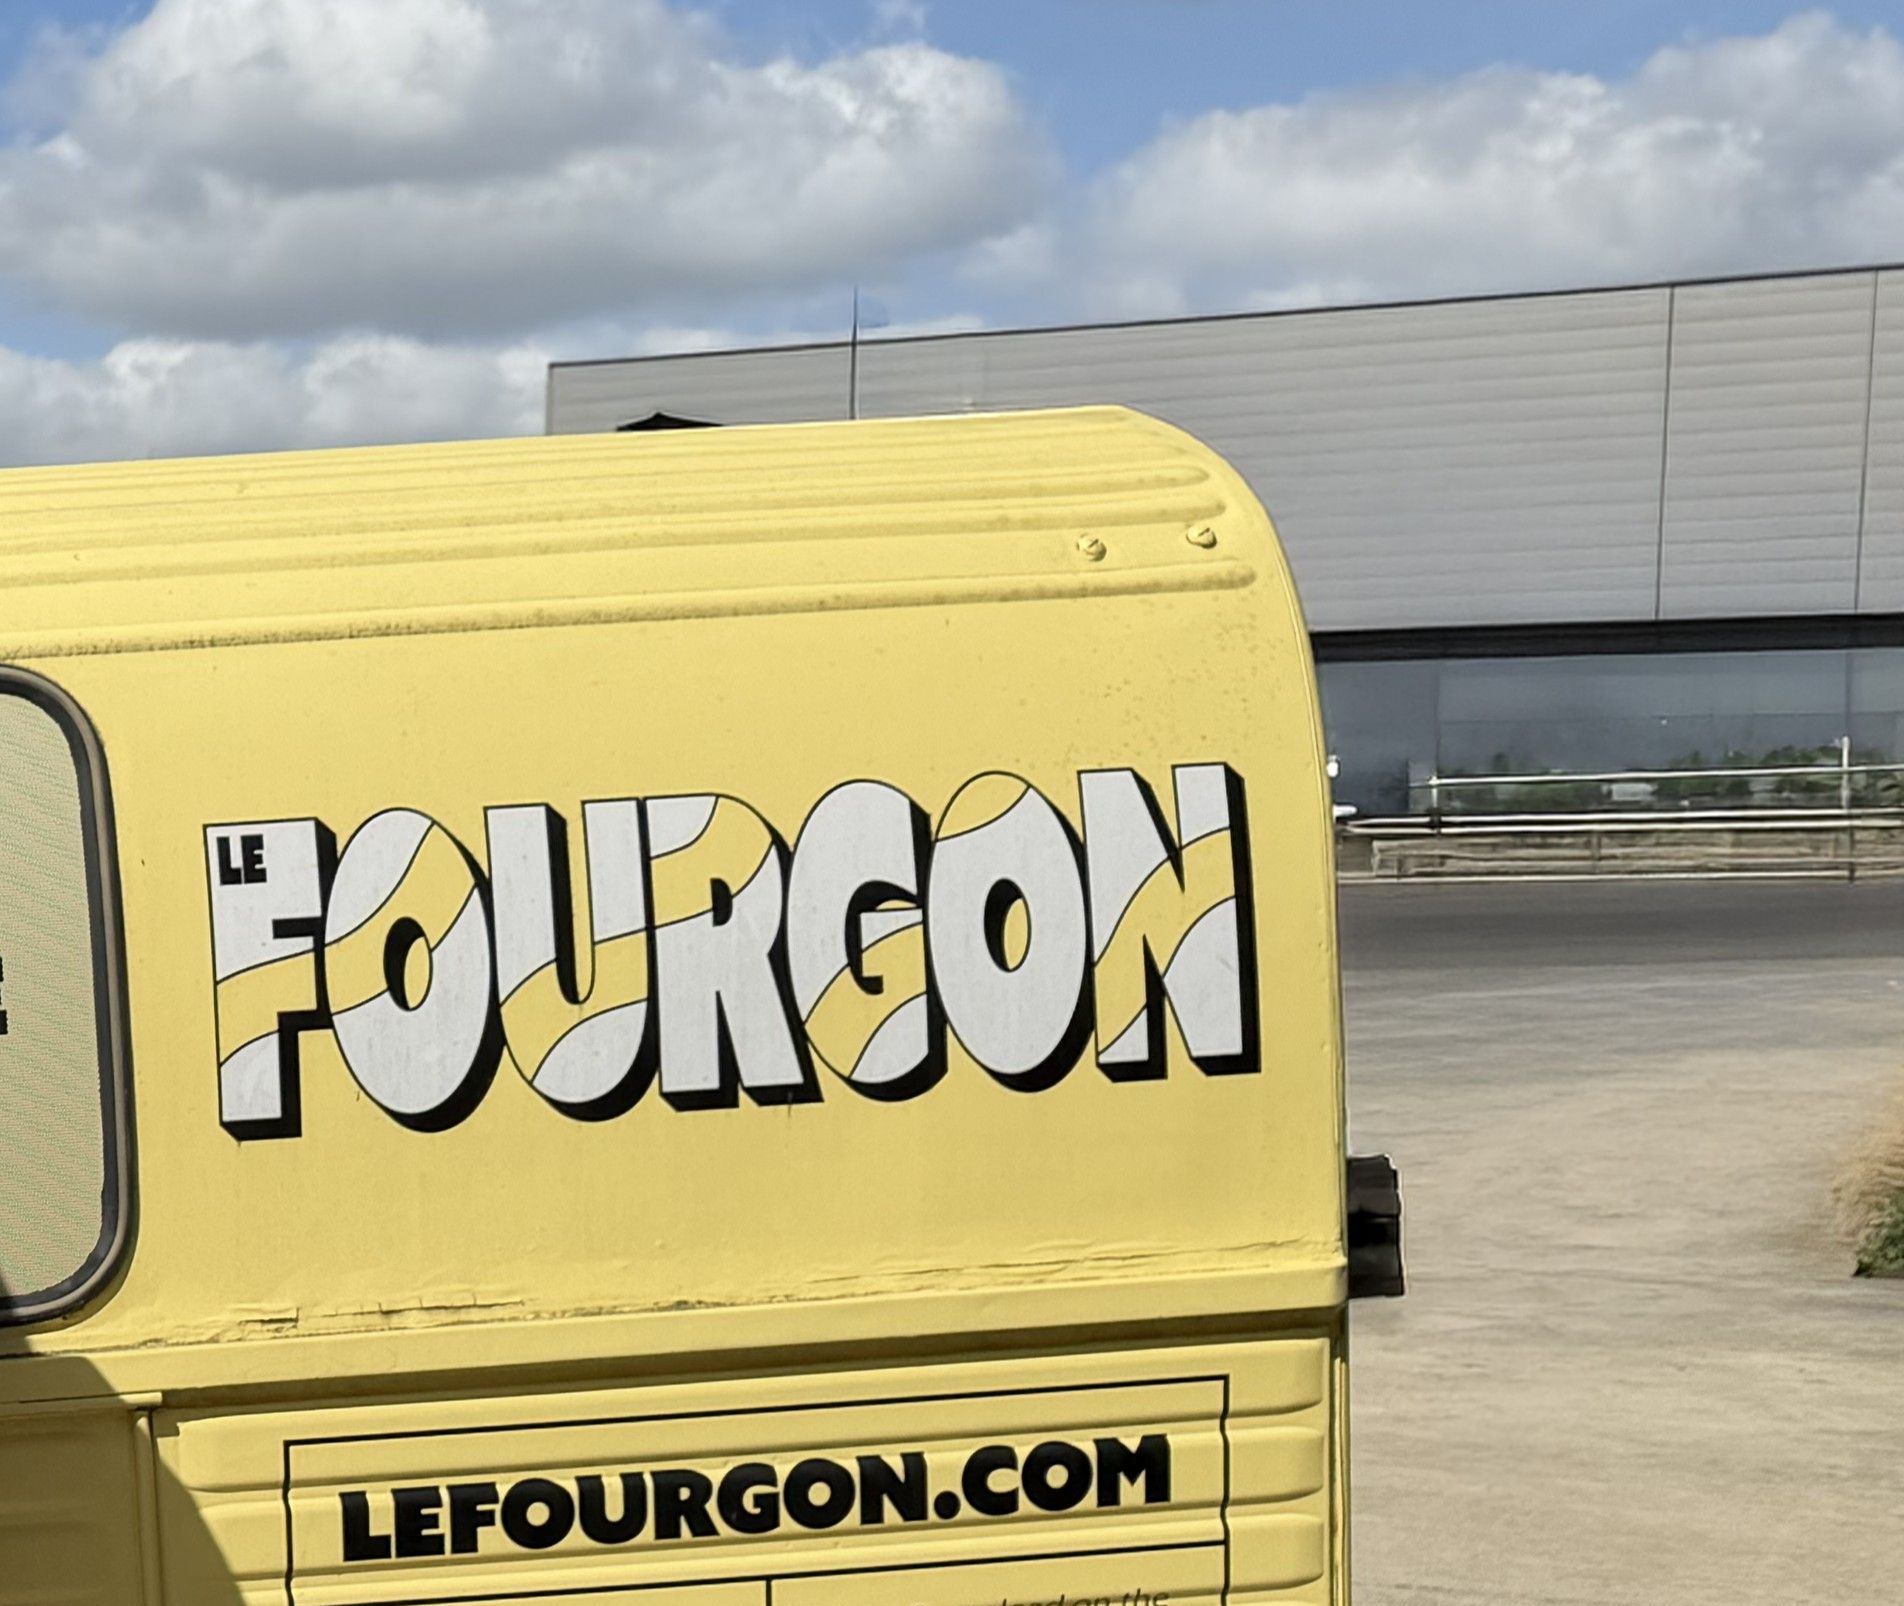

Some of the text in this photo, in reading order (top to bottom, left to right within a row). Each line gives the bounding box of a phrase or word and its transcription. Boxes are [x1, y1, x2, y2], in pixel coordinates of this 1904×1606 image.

[203, 762, 1261, 1142] LE FOURGON
[338, 1433, 1173, 1563] LEFOURGON.COM
